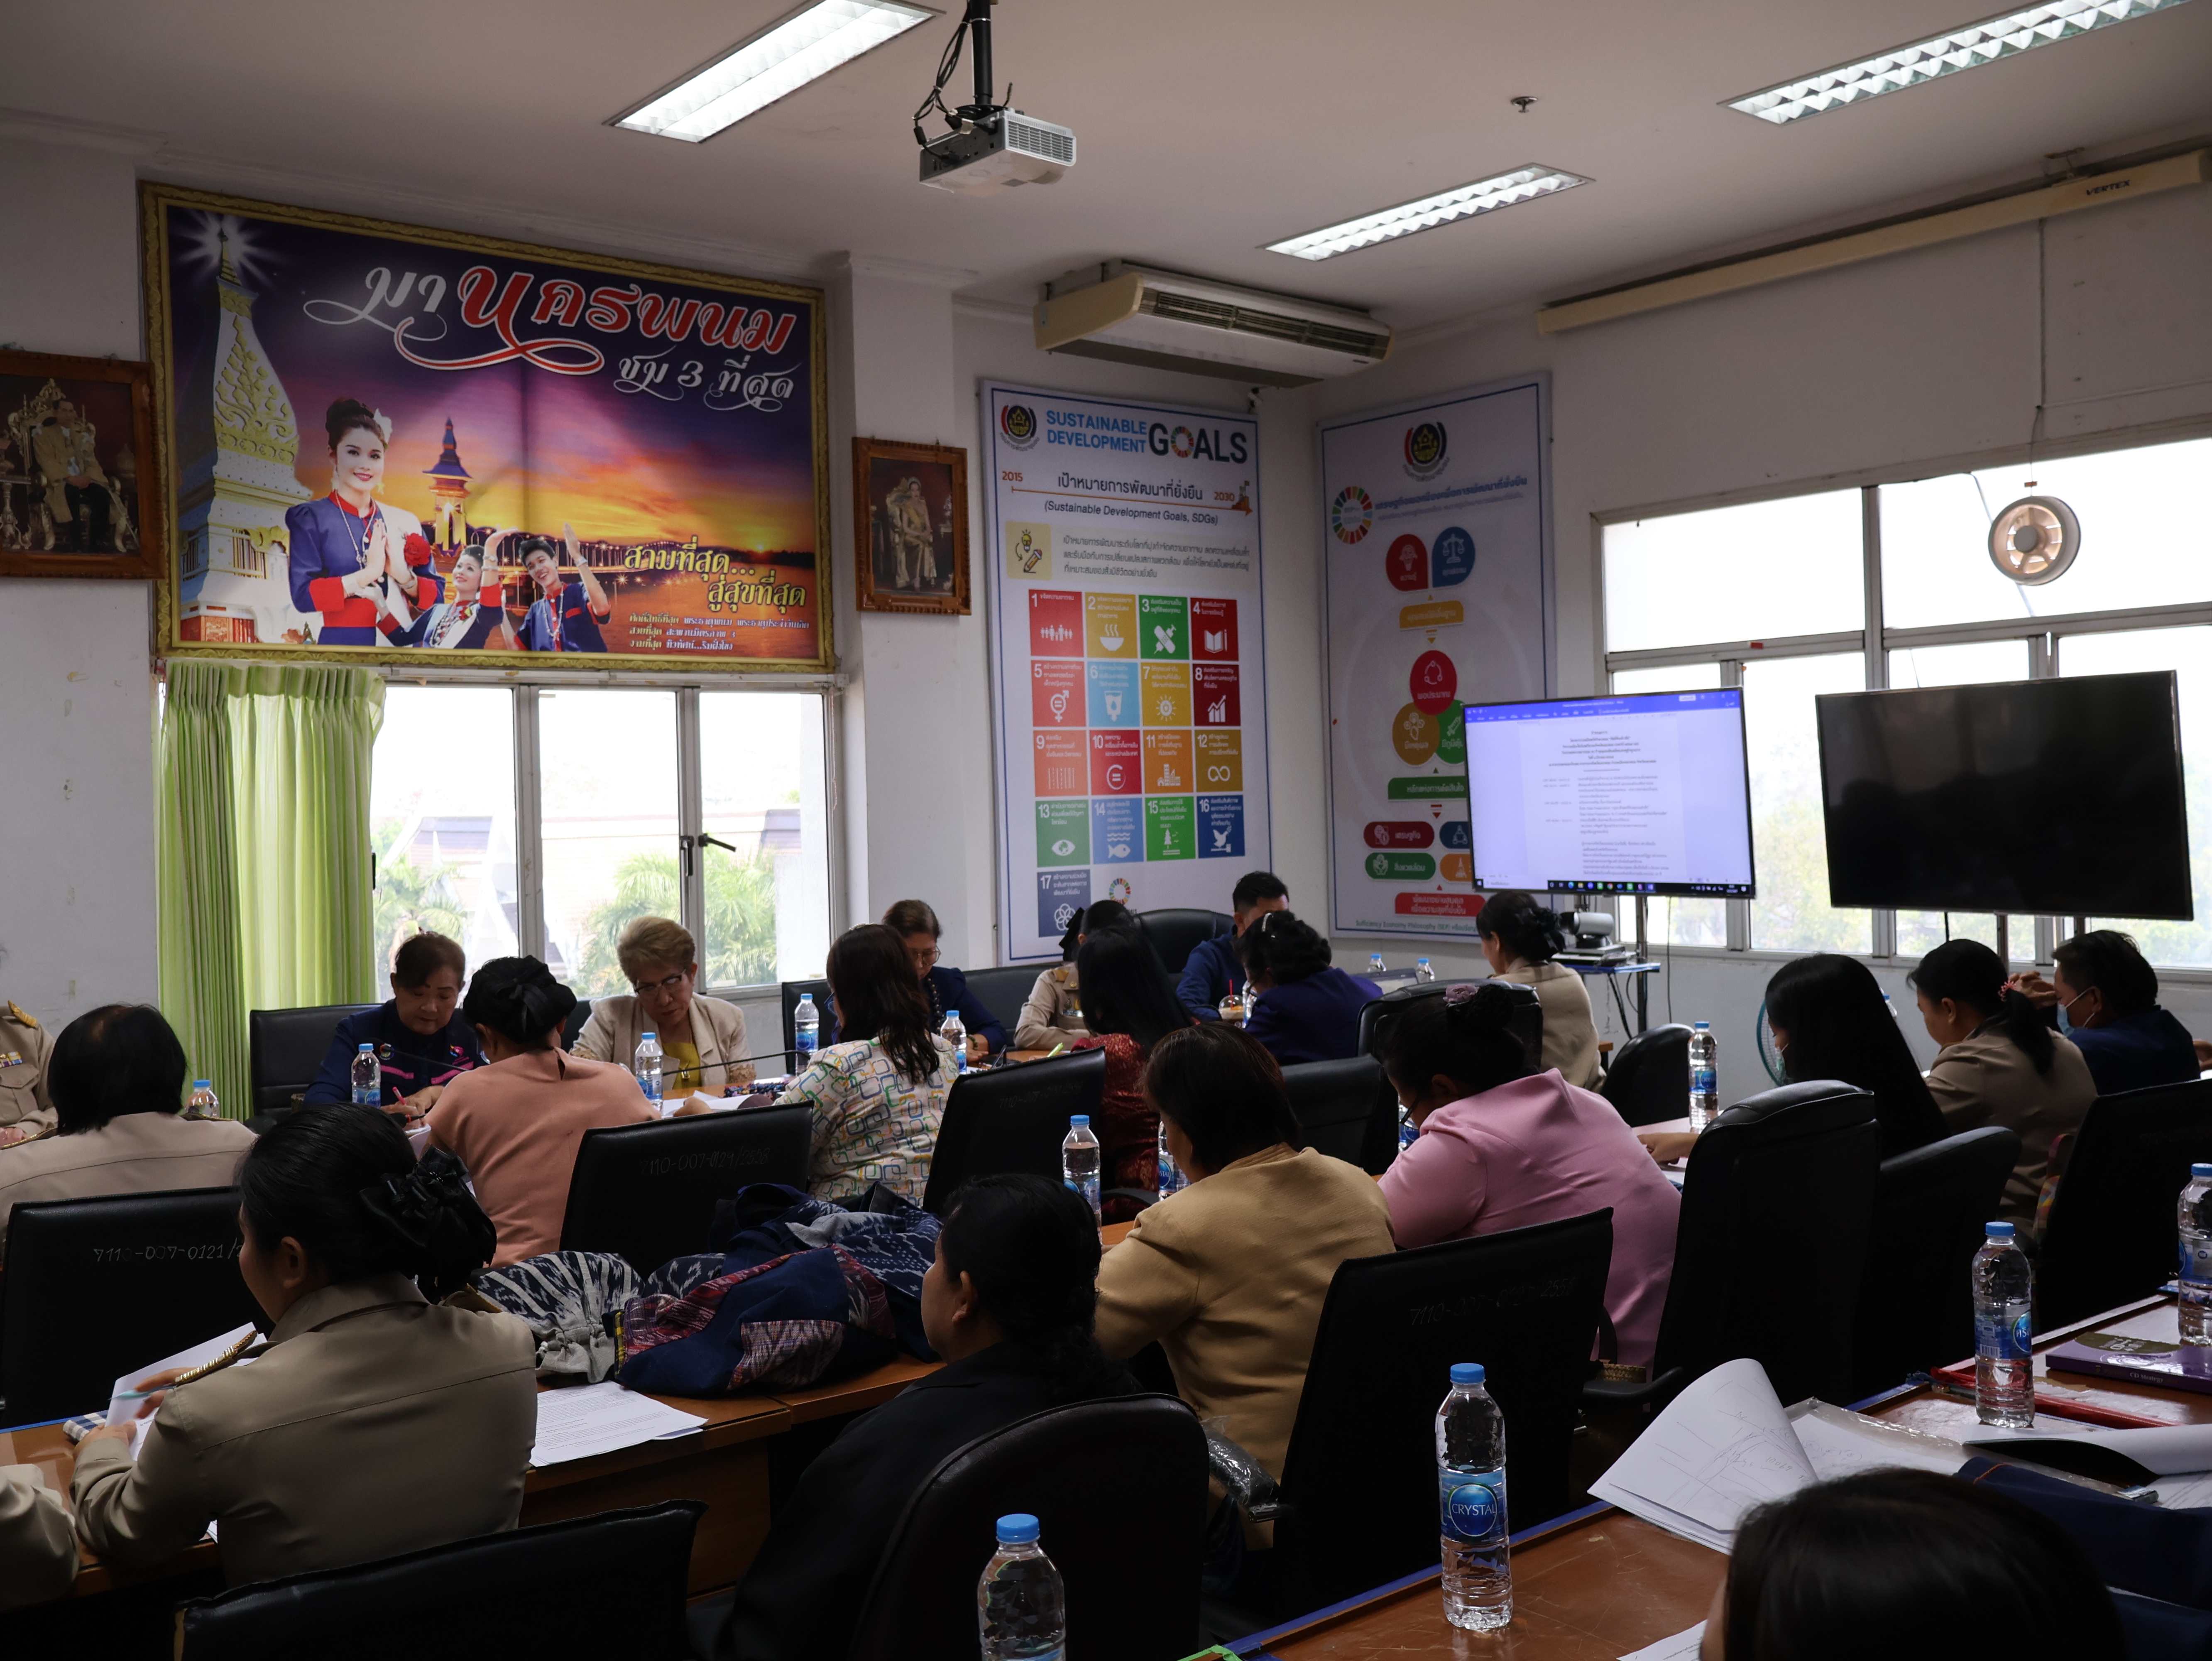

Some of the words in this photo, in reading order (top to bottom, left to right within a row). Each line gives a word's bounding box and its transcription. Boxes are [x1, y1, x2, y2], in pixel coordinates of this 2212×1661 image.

[2087, 180, 2131, 196] VERTEX
[394, 266, 797, 375] นครพนม
[678, 360, 704, 387] 3
[1047, 410, 1147, 435] SUSTAINABLE
[1047, 429, 1146, 453] DEVELOPMENT
[1148, 422, 1248, 464] GOALS
[1002, 471, 1023, 482] 2015
[1058, 472, 1203, 500] เป้าหมายการพัฒนาที่ยั่งยืน
[1214, 491, 1235, 502] 2030
[1045, 500, 1101, 514] (Sustainable
[1104, 505, 1161, 519] Development
[1164, 511, 1189, 523] Goals,
[1192, 513, 1219, 526] SDGs)
[624, 535, 755, 581] สามที่สุด...
[708, 570, 806, 614] สู่สุขที่สุด
[1031, 593, 1038, 608] 1
[1088, 595, 1096, 610] 2
[1142, 598, 1150, 612] 3
[1193, 601, 1201, 615] 4
[1034, 664, 1043, 678] 5
[1089, 665, 1099, 679] 6
[1143, 666, 1150, 680] 7
[1195, 667, 1203, 681] 8
[1036, 735, 1045, 750] 9
[1092, 735, 1104, 749] 10
[1146, 734, 1156, 748] 11
[1197, 734, 1208, 748] 12
[1038, 804, 1050, 818] 13
[1094, 802, 1106, 816] 14
[1148, 800, 1159, 814] 15
[1199, 799, 1210, 813] 16
[1040, 875, 1052, 889] 17
[2140, 1374, 2164, 1383] Strategy
[1452, 1503, 1497, 1516] CRYSTAL
